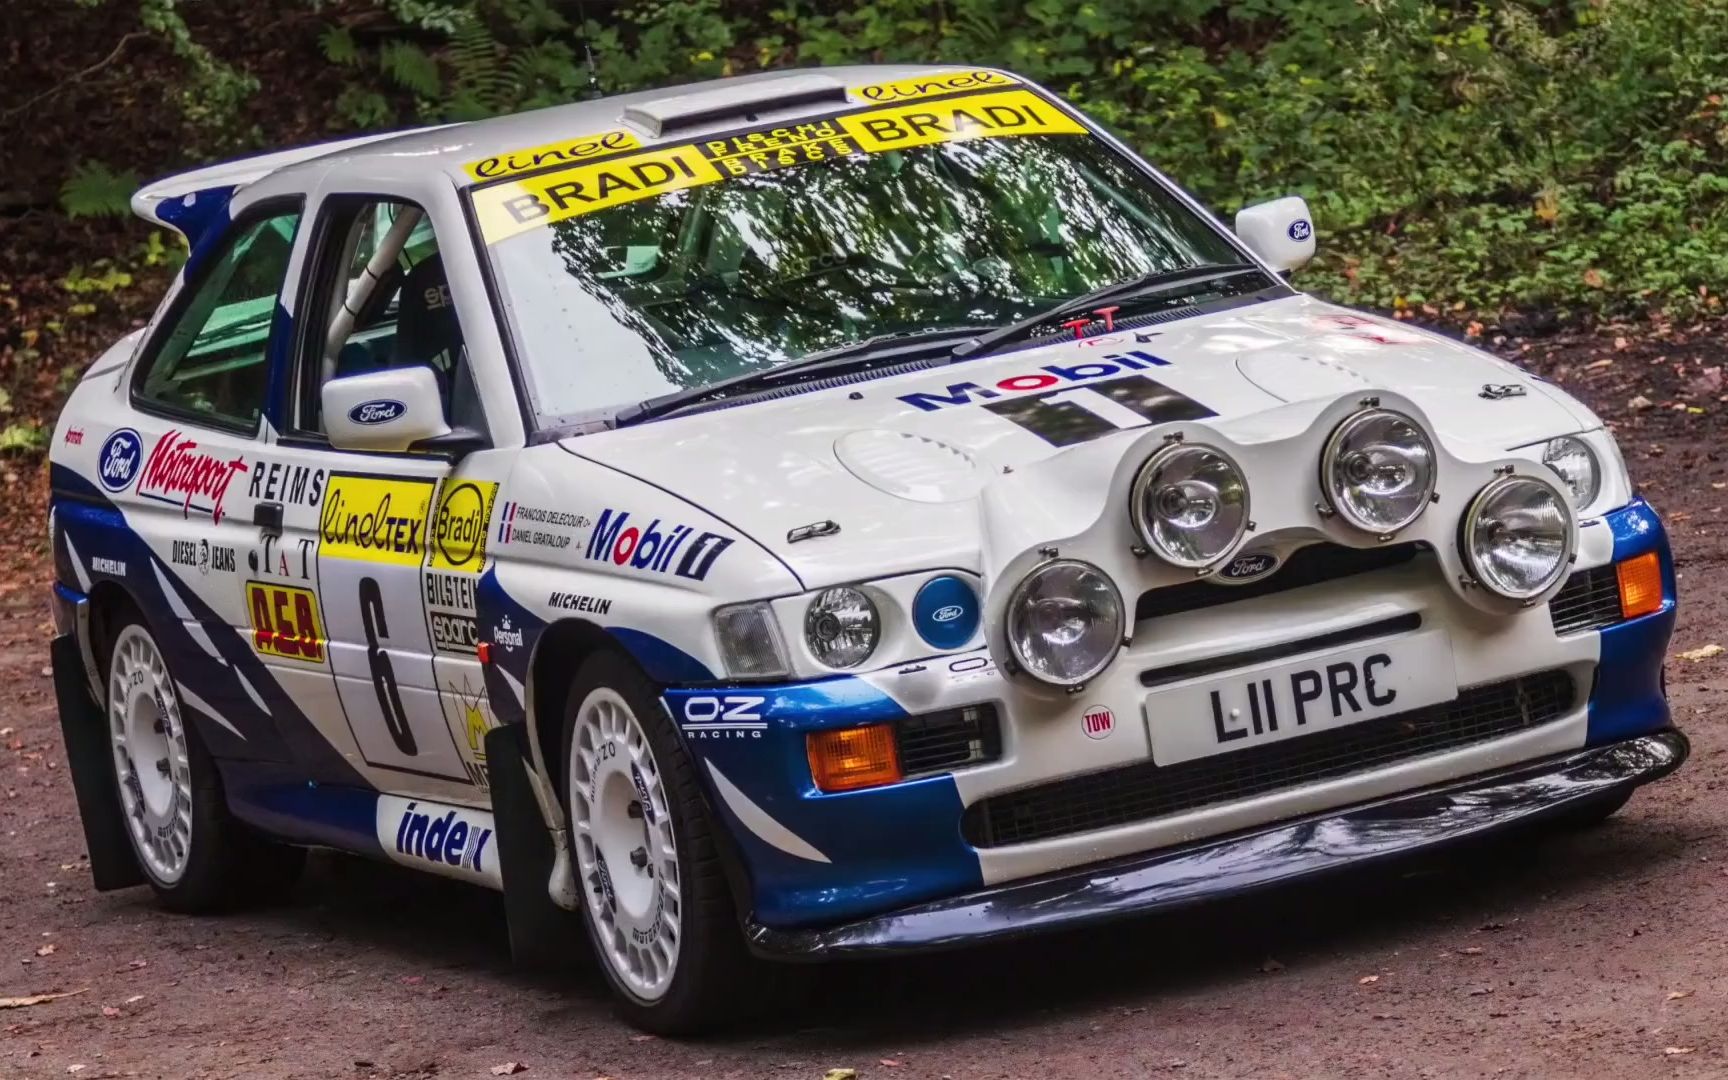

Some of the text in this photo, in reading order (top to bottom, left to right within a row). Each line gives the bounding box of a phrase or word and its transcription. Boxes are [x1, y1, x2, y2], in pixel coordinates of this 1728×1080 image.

[706, 121, 832, 148] DISCHI
[860, 105, 1045, 143] BRADI
[504, 156, 696, 224] BRADI
[896, 350, 1173, 412] Mobil
[360, 403, 395, 422] Ford
[104, 437, 134, 479] Ford
[135, 429, 248, 525] Motorsport
[249, 461, 324, 507] REIMS
[438, 506, 480, 543] Bradi
[546, 511, 583, 528] DELECOUR
[512, 528, 532, 544] DANIEL
[533, 532, 571, 548] GRATALOUP
[585, 508, 694, 573] Mobil
[92, 557, 127, 577] MICHELIN
[172, 540, 236, 572] DIESEL JEANS
[1231, 556, 1266, 577] Ford
[426, 573, 478, 609] BILSTEI
[548, 592, 612, 615] MICHELIN
[494, 626, 523, 646] Personal
[359, 577, 417, 756] 6
[1210, 653, 1397, 744] L11 PRC
[687, 731, 761, 739] RACING
[1085, 711, 1111, 733] TOW
